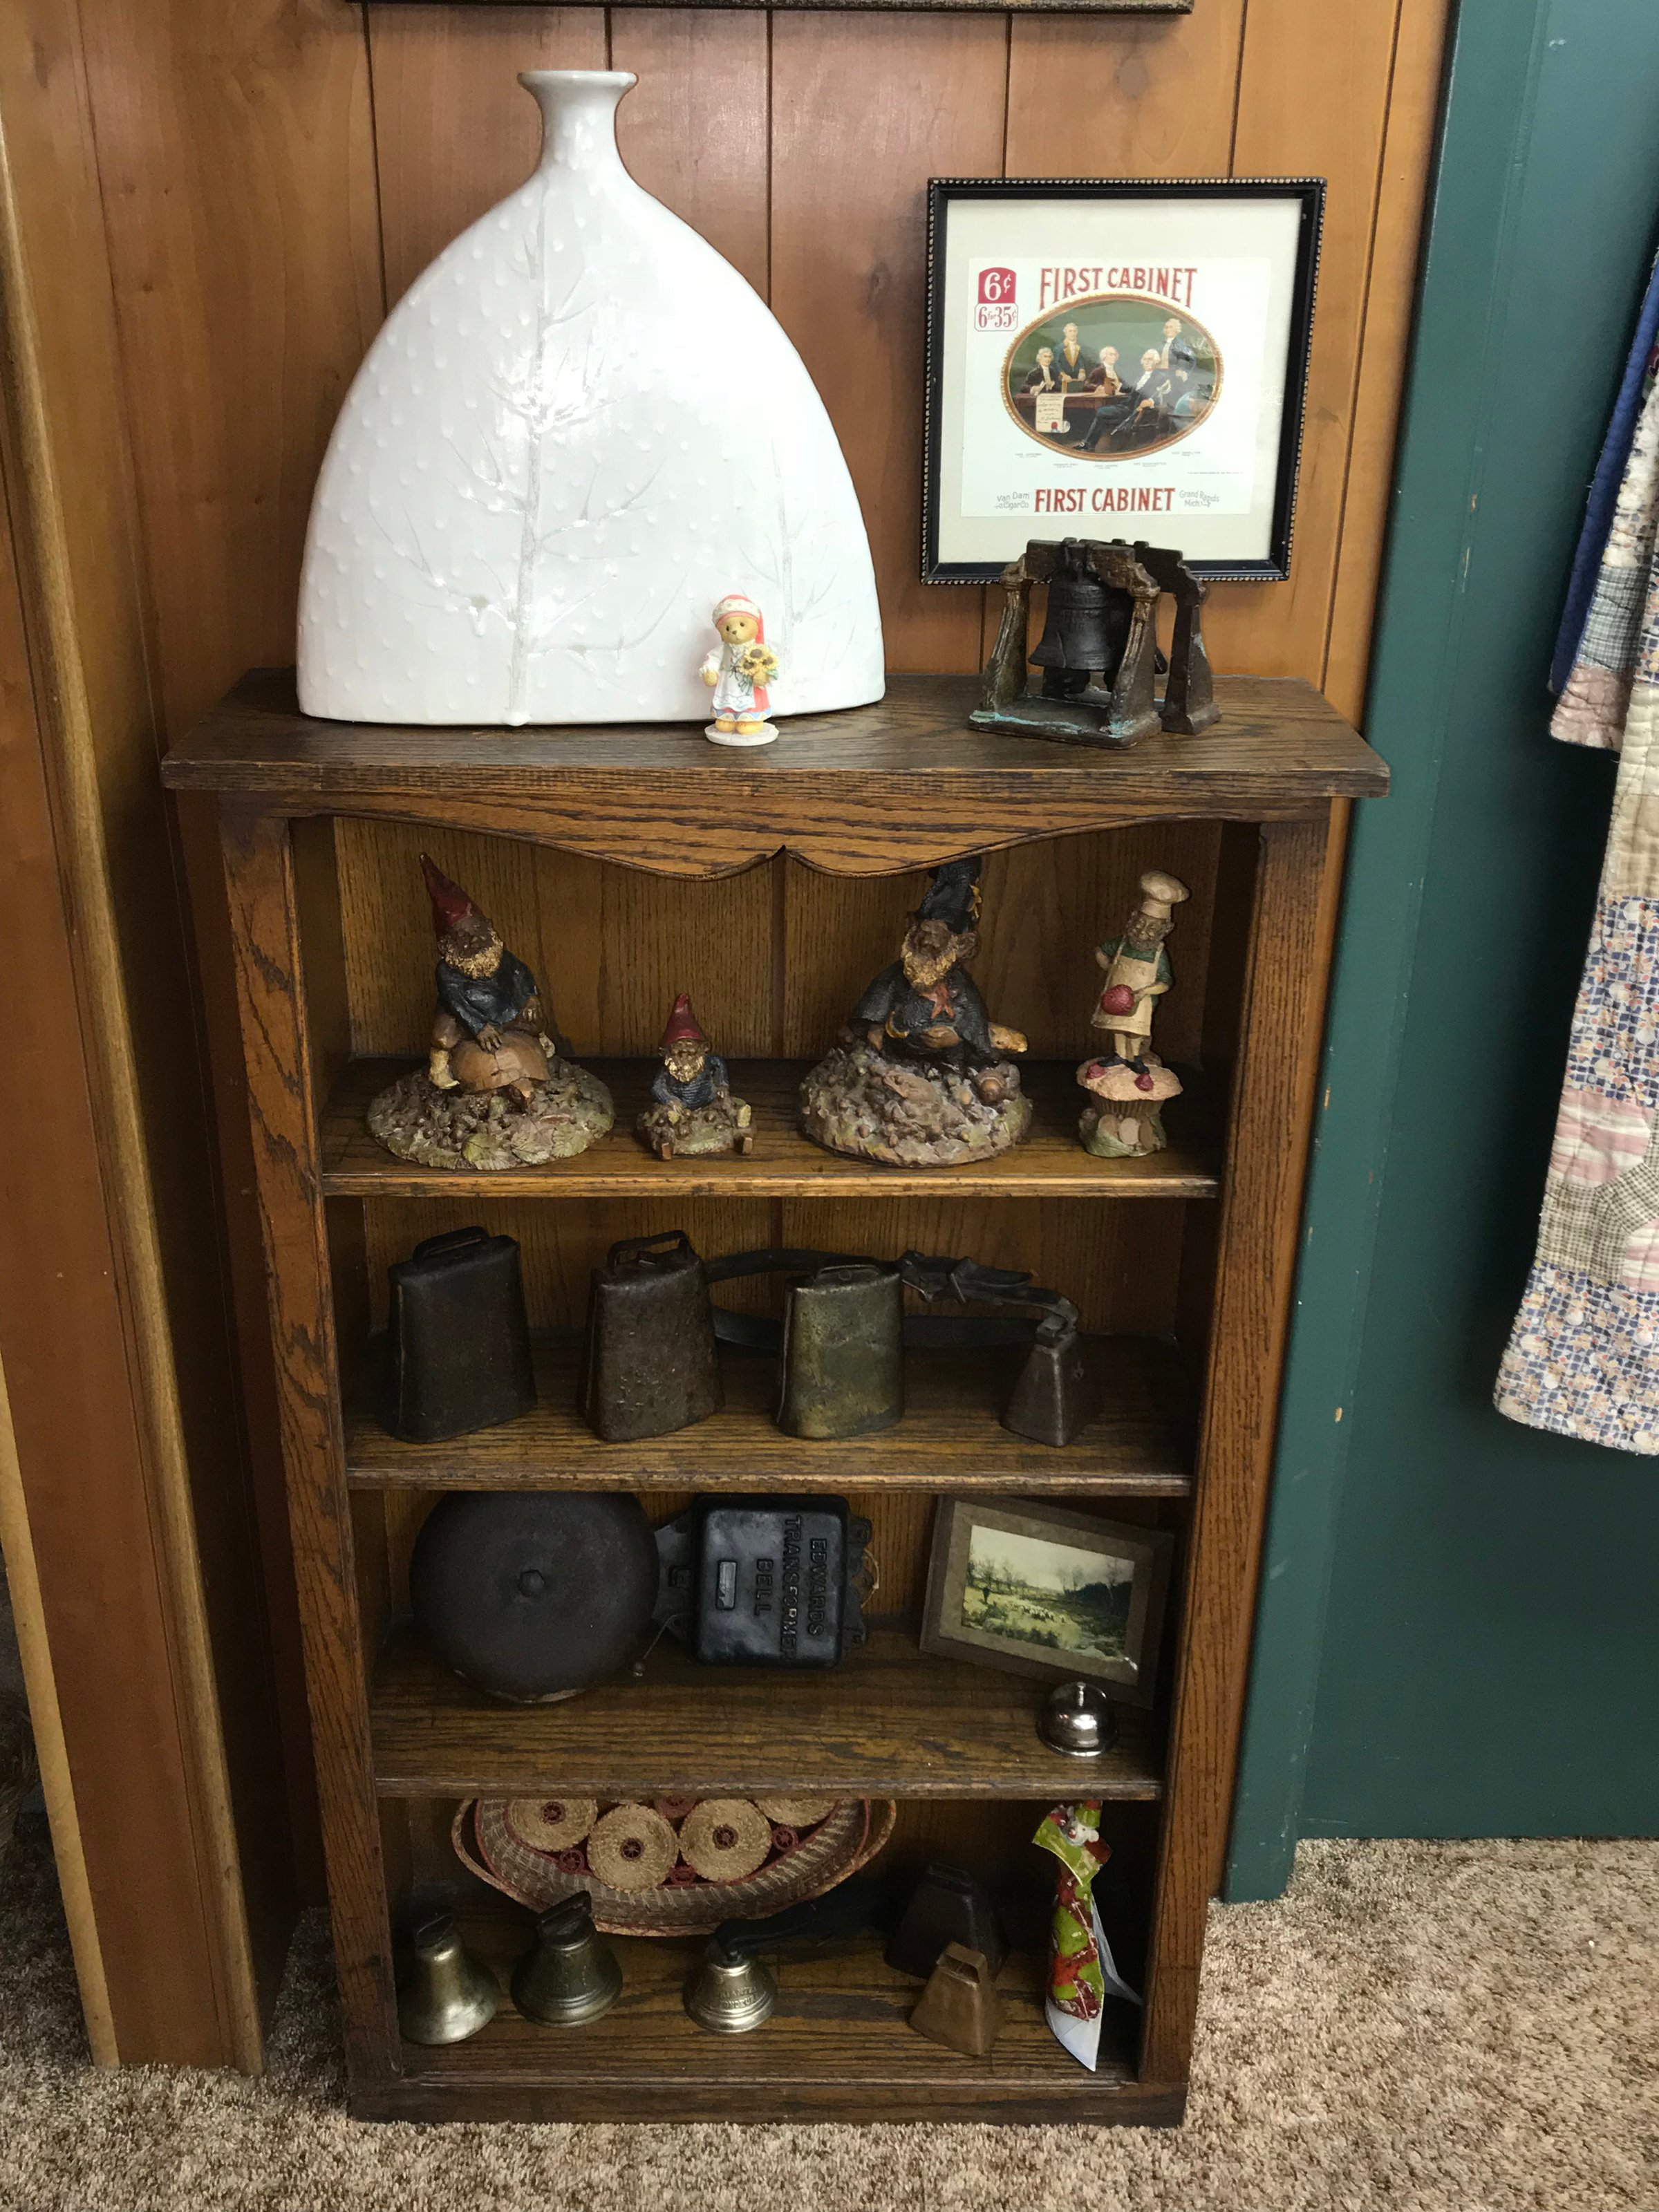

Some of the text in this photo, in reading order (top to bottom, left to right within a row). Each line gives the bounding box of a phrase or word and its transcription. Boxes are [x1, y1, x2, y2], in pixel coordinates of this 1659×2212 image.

[984, 272, 1011, 301] 6¢
[1039, 268, 1197, 311] FIRST CABINET
[997, 494, 1010, 503] Van
[1004, 501, 1020, 510] Cigar
[1035, 487, 1175, 512] FIRST CABINET
[1179, 490, 1219, 502] Grand Rapids
[754, 1559, 774, 1617] BELL
[780, 1515, 801, 1659] TRANSFORMER
[808, 1538, 827, 1636] EDWARDS
